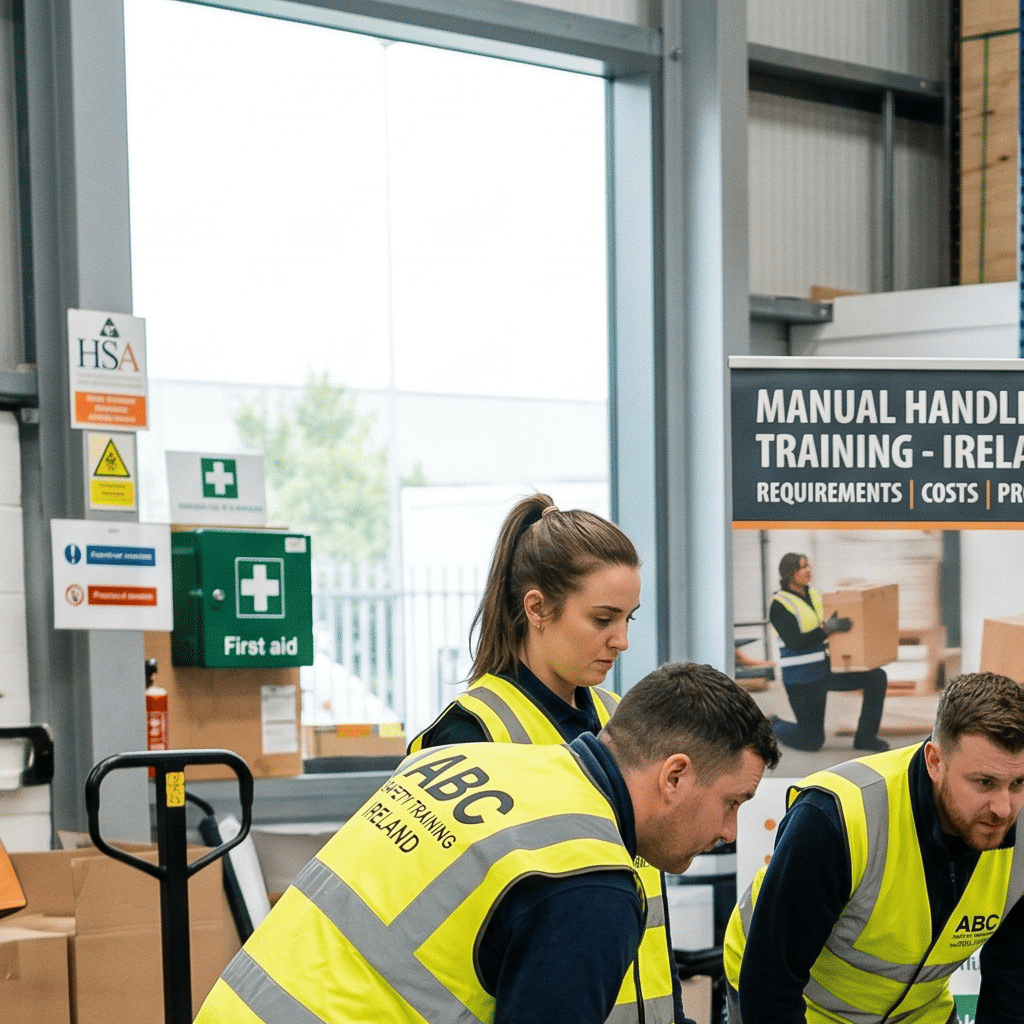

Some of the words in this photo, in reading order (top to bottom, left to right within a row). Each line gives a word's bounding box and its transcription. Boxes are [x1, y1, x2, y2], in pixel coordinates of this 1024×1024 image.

[77, 338, 140, 371] HSA
[756, 389, 897, 424] MANUAL
[755, 433, 914, 469] TRAINING
[756, 481, 903, 506] REQUIREMENTS
[921, 482, 979, 504] COSTS
[223, 635, 266, 656] First
[269, 636, 298, 656] aid
[403, 754, 515, 825] ABC
[361, 801, 420, 853] IRELAND
[407, 799, 457, 849] TRAINING
[955, 914, 1000, 933] ABC
